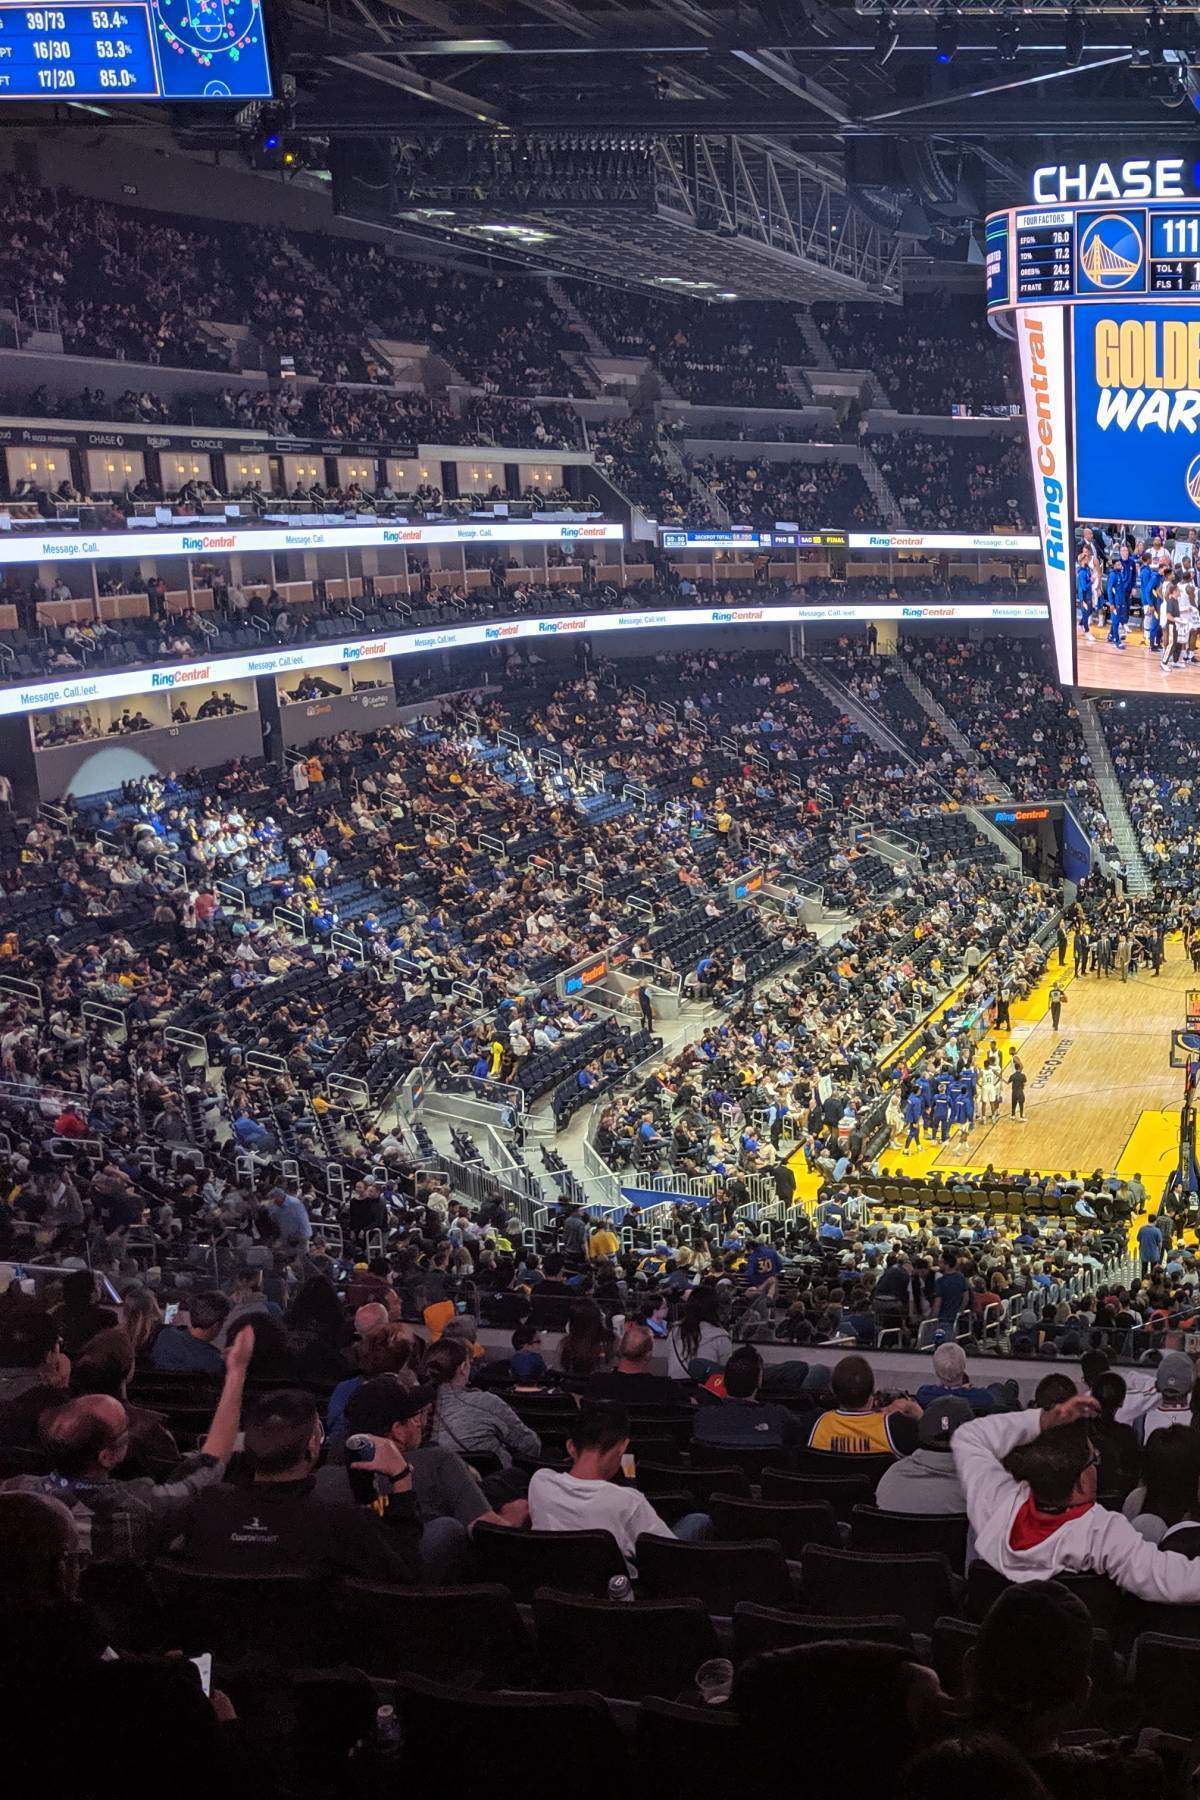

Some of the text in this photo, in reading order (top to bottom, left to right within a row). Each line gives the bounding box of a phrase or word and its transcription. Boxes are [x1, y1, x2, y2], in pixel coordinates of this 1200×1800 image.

[92, 11, 128, 29] 53.4%
[97, 40, 132, 58] 53.3%
[100, 70, 136, 87] 85.0%
[1033, 159, 1185, 203] CHASE
[1023, 214, 1065, 225] FOUR FACTORS
[1163, 219, 1198, 253] 111
[1055, 248, 1070, 260] 17.2
[1053, 264, 1070, 275] 24.2
[1156, 262, 1182, 273] TOL 4
[1053, 280, 1070, 291] 27.4
[1156, 280, 1182, 289] FLS 1
[89, 434, 116, 446] CHASE
[190, 439, 224, 449] ORACLE
[1027, 318, 1067, 573] RingCentral
[383, 530, 421, 542] RingCentral
[560, 527, 607, 538] RingCentral
[182, 535, 235, 550] RingCentral
[869, 537, 923, 546] RingCentral
[42, 543, 81, 556] Message.
[711, 611, 764, 622] RingCentral
[902, 607, 956, 617] RingCentral
[538, 620, 587, 633] RingCentral
[343, 642, 387, 659] RingCentral
[152, 666, 211, 686] RingCentral
[20, 690, 62, 705] Message.
[995, 808, 1049, 822] RingCentral
[1030, 1066, 1056, 1089] CHASE
